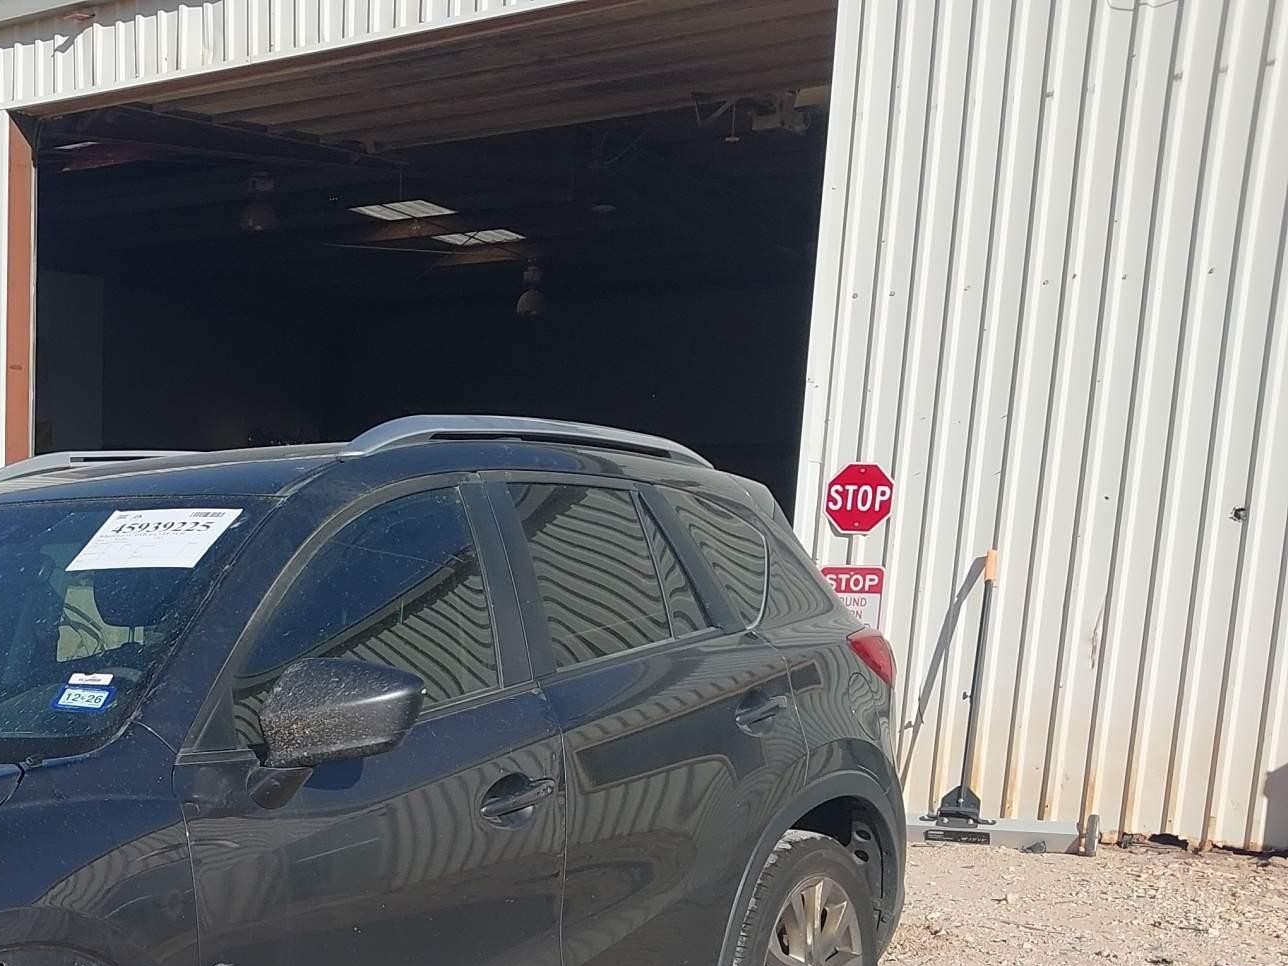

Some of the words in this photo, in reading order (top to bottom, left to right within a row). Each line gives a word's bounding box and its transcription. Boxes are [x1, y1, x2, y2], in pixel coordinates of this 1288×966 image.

[828, 484, 891, 512] STOP
[112, 521, 215, 534] 45939225
[825, 573, 879, 592] STOP
